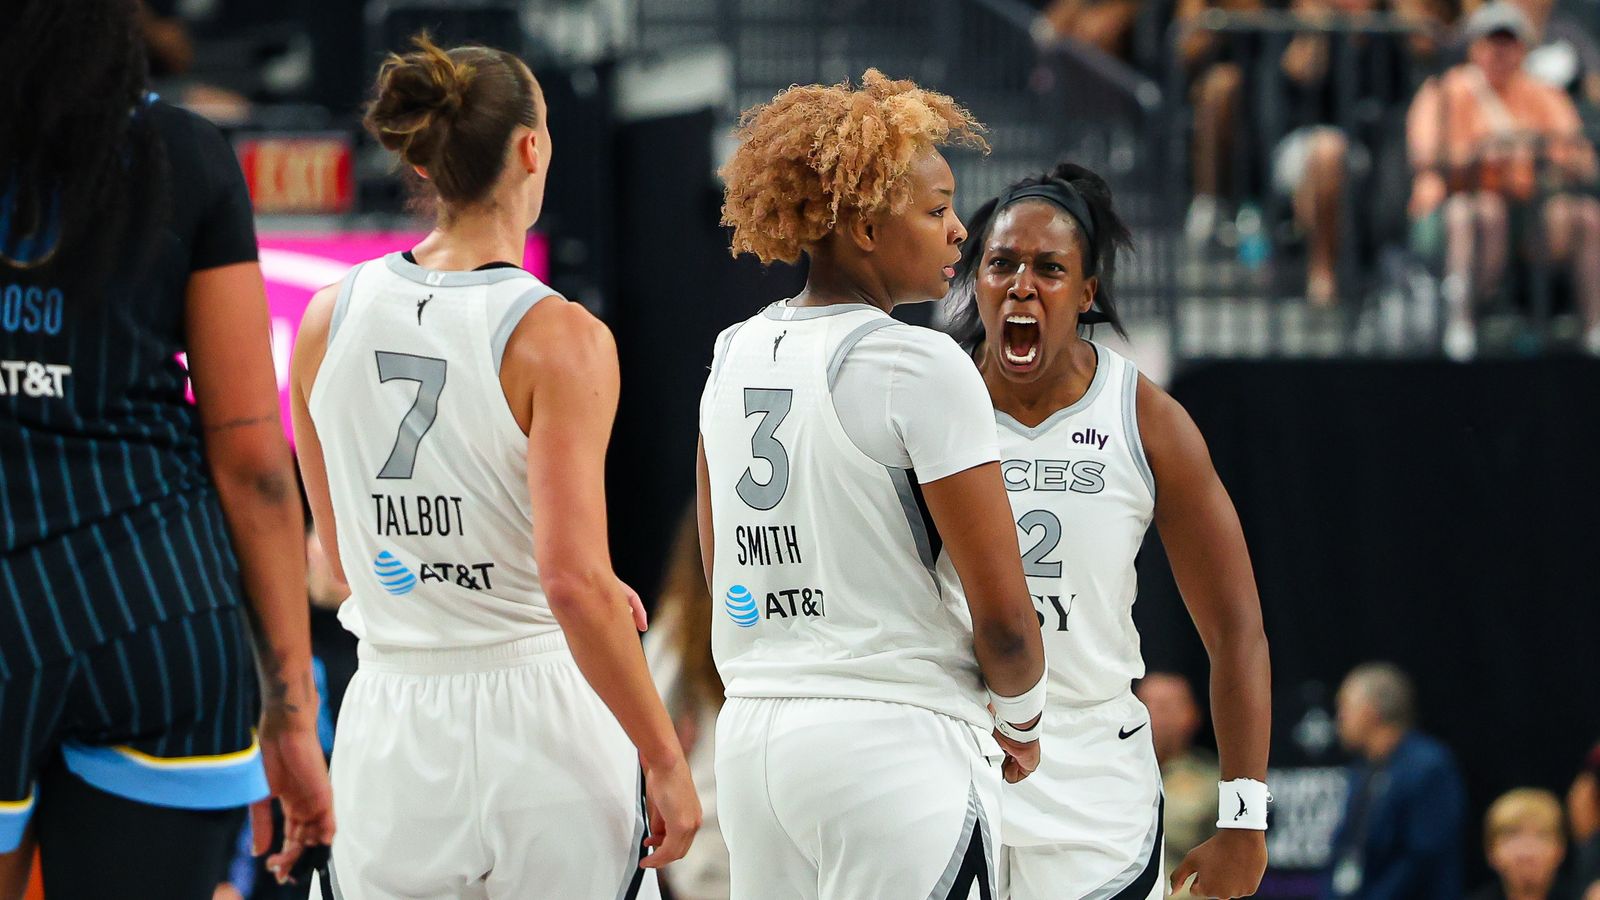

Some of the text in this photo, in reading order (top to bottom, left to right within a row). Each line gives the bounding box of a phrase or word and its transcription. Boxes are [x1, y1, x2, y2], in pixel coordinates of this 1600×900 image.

[0, 283, 64, 336] OSO
[375, 350, 447, 479] 7
[735, 388, 793, 511] 3
[1071, 428, 1109, 450] ally
[1000, 459, 1106, 494] CES
[371, 494, 464, 536] TALBOT
[736, 525, 802, 565] SMITH
[420, 563, 494, 590] AT&T
